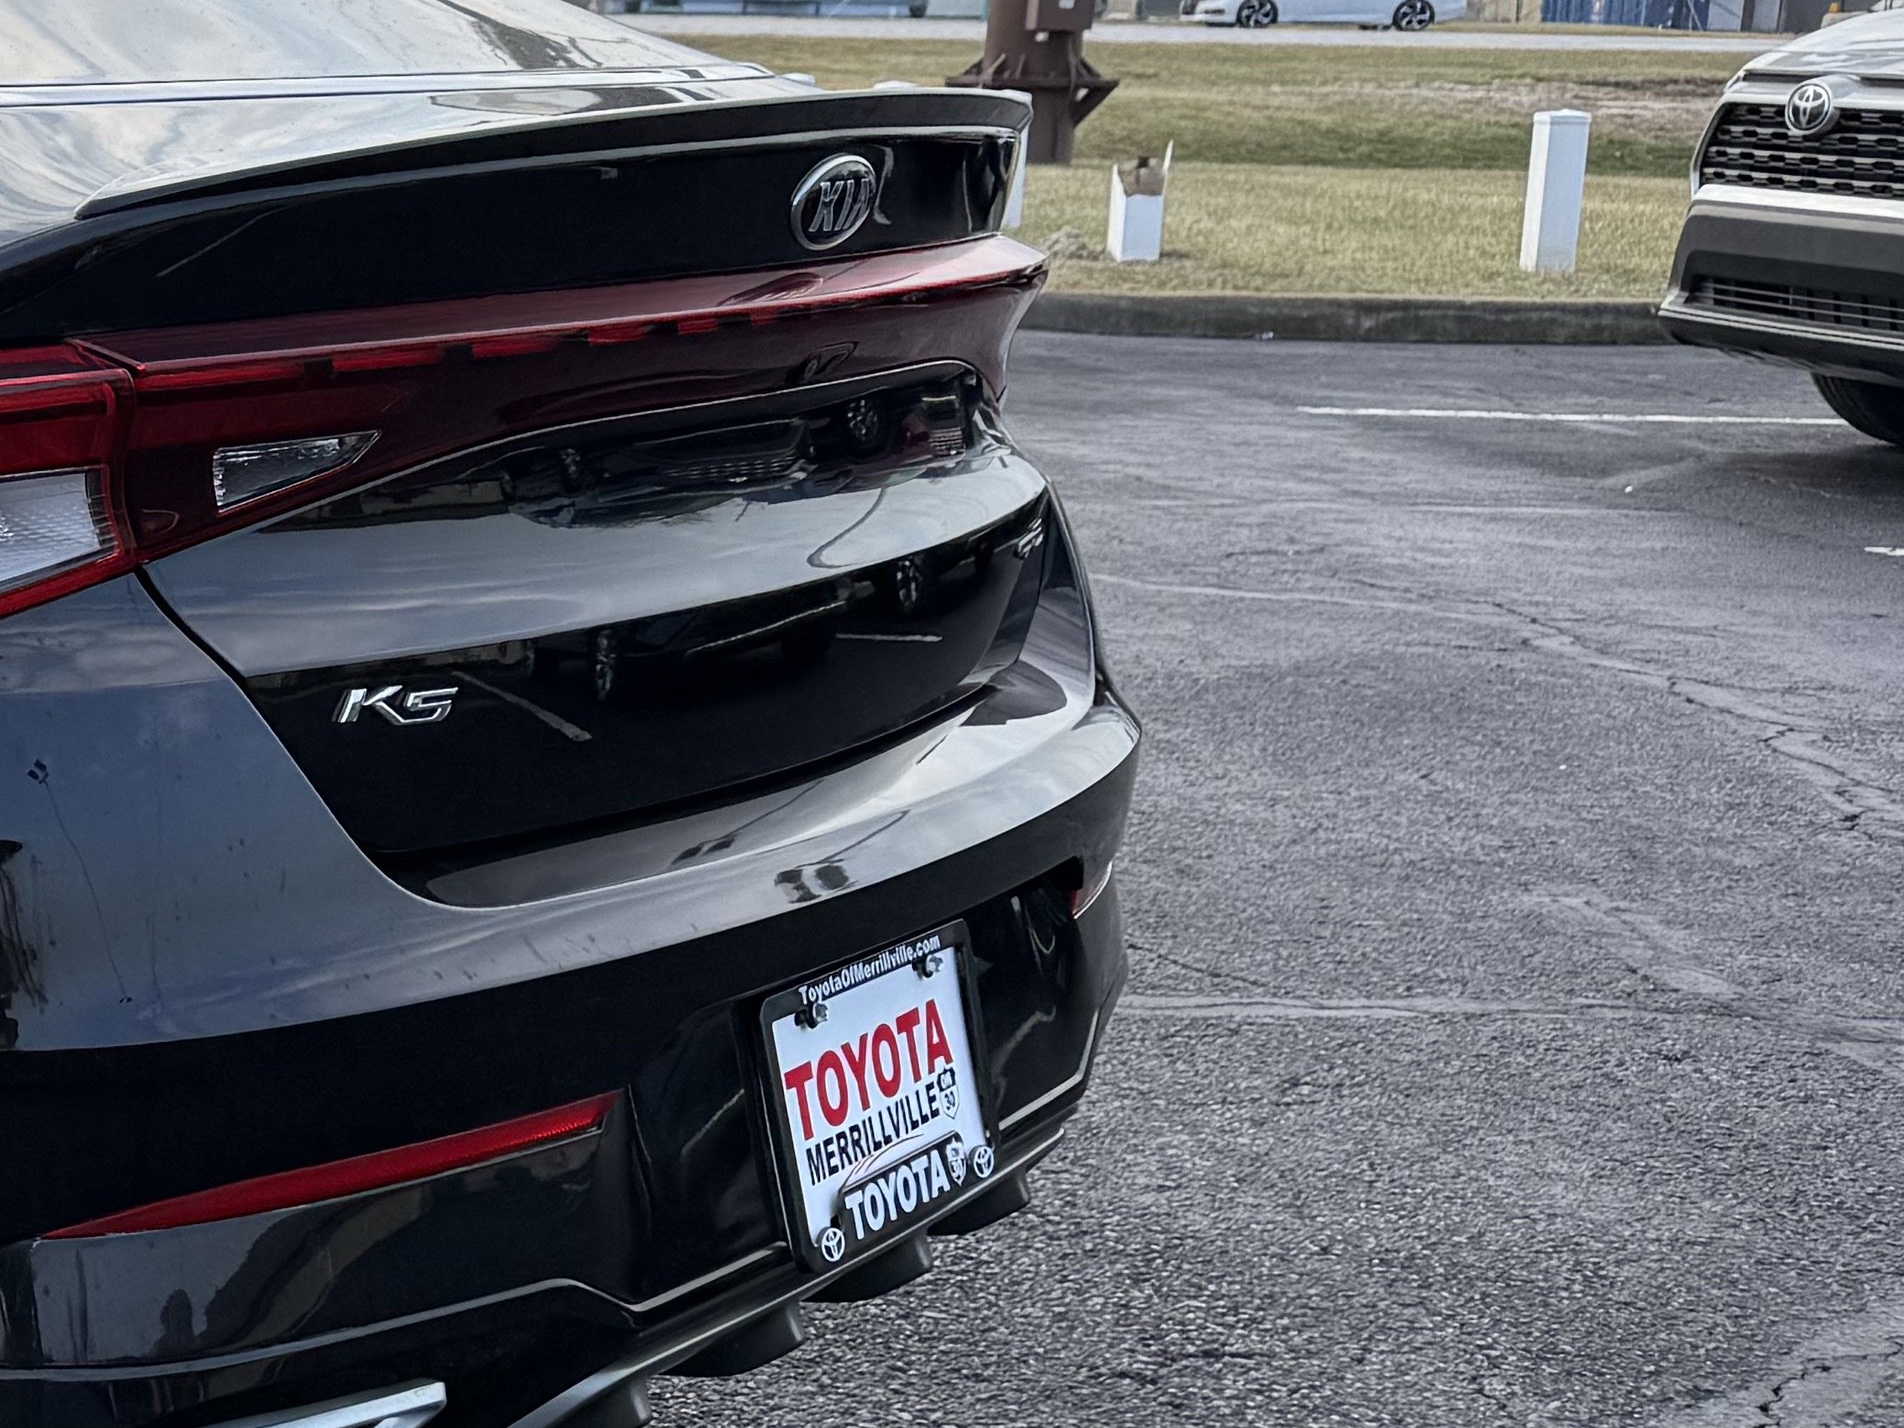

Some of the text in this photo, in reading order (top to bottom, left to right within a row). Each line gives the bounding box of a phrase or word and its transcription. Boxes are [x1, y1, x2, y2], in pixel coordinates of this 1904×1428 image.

[808, 177, 870, 233] KIA
[335, 684, 459, 727] K5
[784, 998, 955, 1140] TOYOTA
[806, 1081, 941, 1187] MERRILLVILLE
[845, 1153, 952, 1240] TOYOTA
